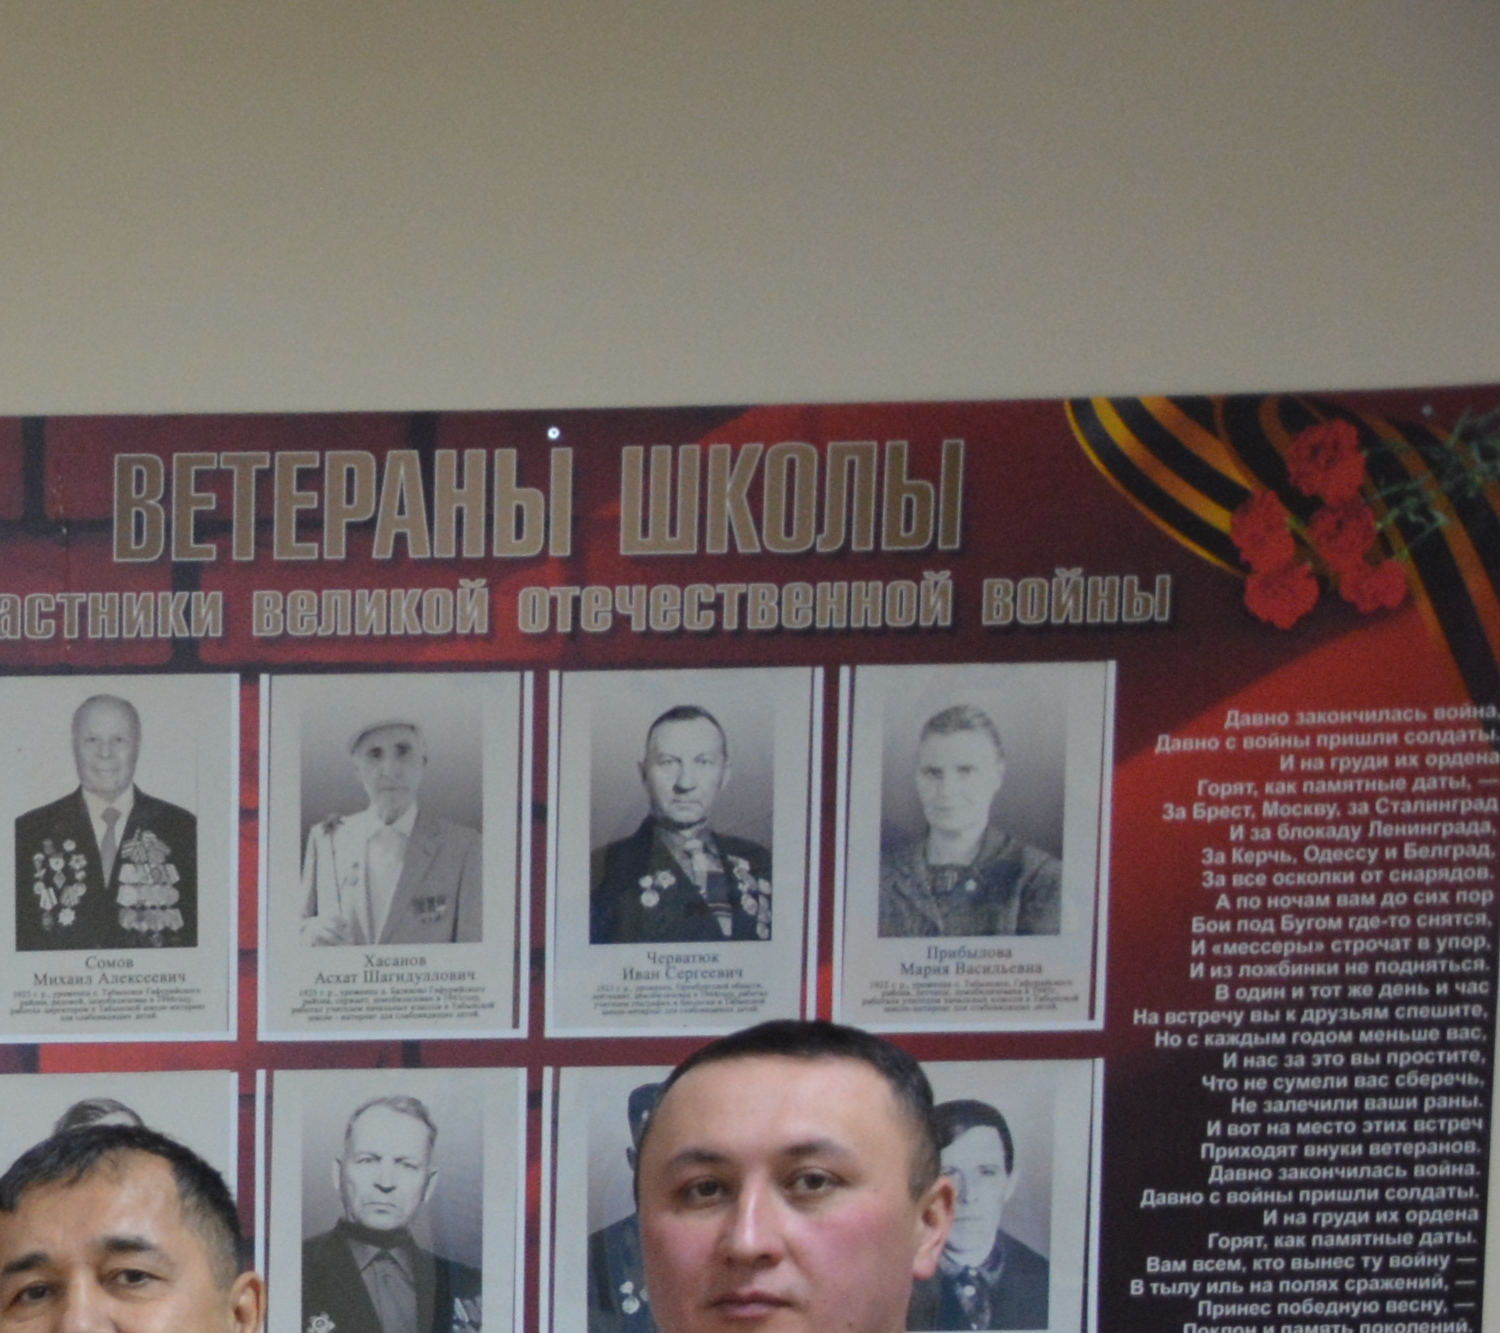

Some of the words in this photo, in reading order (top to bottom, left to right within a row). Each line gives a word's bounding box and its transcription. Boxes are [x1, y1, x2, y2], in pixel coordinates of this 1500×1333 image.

[111, 442, 574, 563] ВЕТЕРАНЫ
[616, 436, 967, 559] ШКОЛЫ
[250, 576, 490, 640] великой
[517, 568, 954, 636] отечественной
[980, 566, 1173, 629] войны
[1162, 803, 1187, 821] За
[1347, 802, 1370, 816] за
[1376, 795, 1499, 817] Сталинград
[1229, 825, 1245, 842] И
[1250, 827, 1272, 842] за
[1276, 822, 1362, 844] блокаду
[1201, 847, 1226, 866] За
[1303, 844, 1379, 867] Одессу
[1384, 847, 1398, 860] и
[1201, 870, 1227, 888] За
[1231, 873, 1267, 888] все
[1271, 870, 1356, 887] осколки
[1360, 870, 1384, 884] от
[1191, 916, 1232, 934] Бои
[1236, 919, 1276, 934] под
[1280, 913, 1343, 936] Бугом
[1348, 915, 1412, 932] где-то
[646, 951, 720, 966] Черватюк
[1190, 939, 1206, 956] И
[1211, 941, 1325, 960] «мессеры»
[1330, 938, 1412, 957] строчат
[1417, 938, 1431, 951] в
[85, 955, 134, 969] Сомов
[363, 953, 427, 967] Хасанов
[900, 962, 949, 978] Мария
[955, 961, 1043, 976] Васильевна
[1189, 962, 1205, 979] И
[1209, 965, 1233, 979] из
[1238, 958, 1340, 978] ложбинки
[1344, 962, 1370, 975] не
[33, 973, 92, 986] Михаил
[99, 971, 186, 986] Алексеевич
[314, 971, 358, 984] Асхат
[363, 969, 476, 985] Шагидуллович
[622, 967, 660, 981] Иван
[665, 966, 743, 982] Сергеевич
[1132, 1008, 1160, 1026] На
[1164, 1011, 1245, 1029] встречу
[1249, 1010, 1281, 1024] вы
[1285, 1010, 1297, 1022] к
[1300, 1007, 1390, 1026] друзьям
[1231, 1097, 1258, 1114] Не
[1263, 1098, 1359, 1114] залечили
[1364, 1097, 1419, 1112] ваши
[1423, 1096, 1483, 1114] раны.
[1200, 1142, 1299, 1163] Приходят
[1303, 1144, 1364, 1162] внуки
[1368, 1141, 1481, 1160] ветеранов.
[1207, 1164, 1273, 1185] Давно
[1278, 1165, 1408, 1181] закончилась
[1413, 1163, 1481, 1178] война.
[1139, 1188, 1205, 1209] Давно
[1208, 1192, 1221, 1205] с
[1226, 1188, 1294, 1205] войны
[1298, 1188, 1379, 1206] пришли
[1384, 1187, 1479, 1203] солдаты.
[1207, 1232, 1268, 1253] Горят,
[1273, 1235, 1306, 1249] как
[1311, 1233, 1414, 1249] памятные
[1418, 1232, 1477, 1248] даты.
